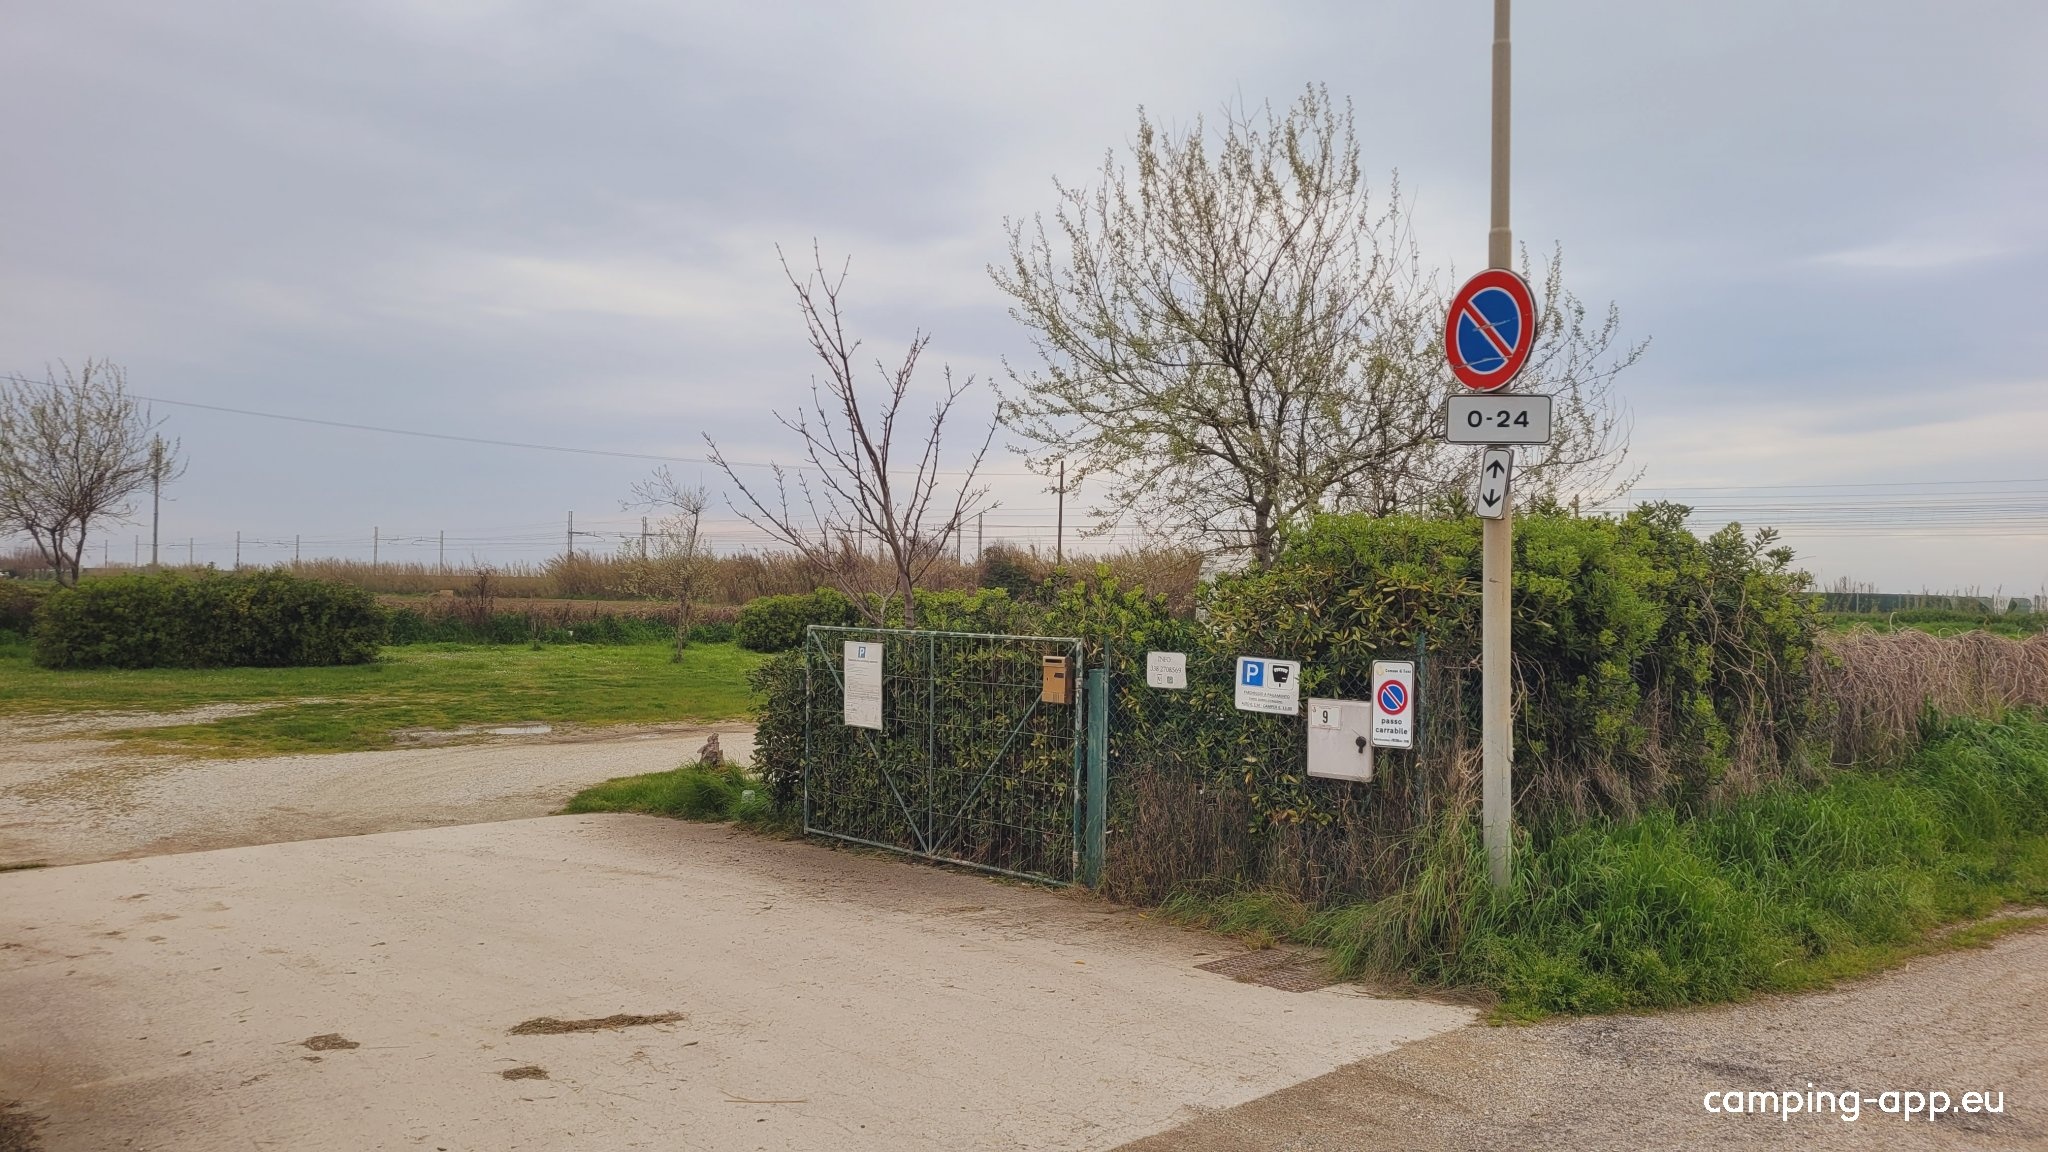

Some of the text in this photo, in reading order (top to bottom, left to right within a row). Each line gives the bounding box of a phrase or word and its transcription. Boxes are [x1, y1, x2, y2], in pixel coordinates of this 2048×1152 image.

[1467, 410, 1529, 428] 0-24
[1246, 664, 1259, 682] P
[1322, 710, 1328, 724] 9
